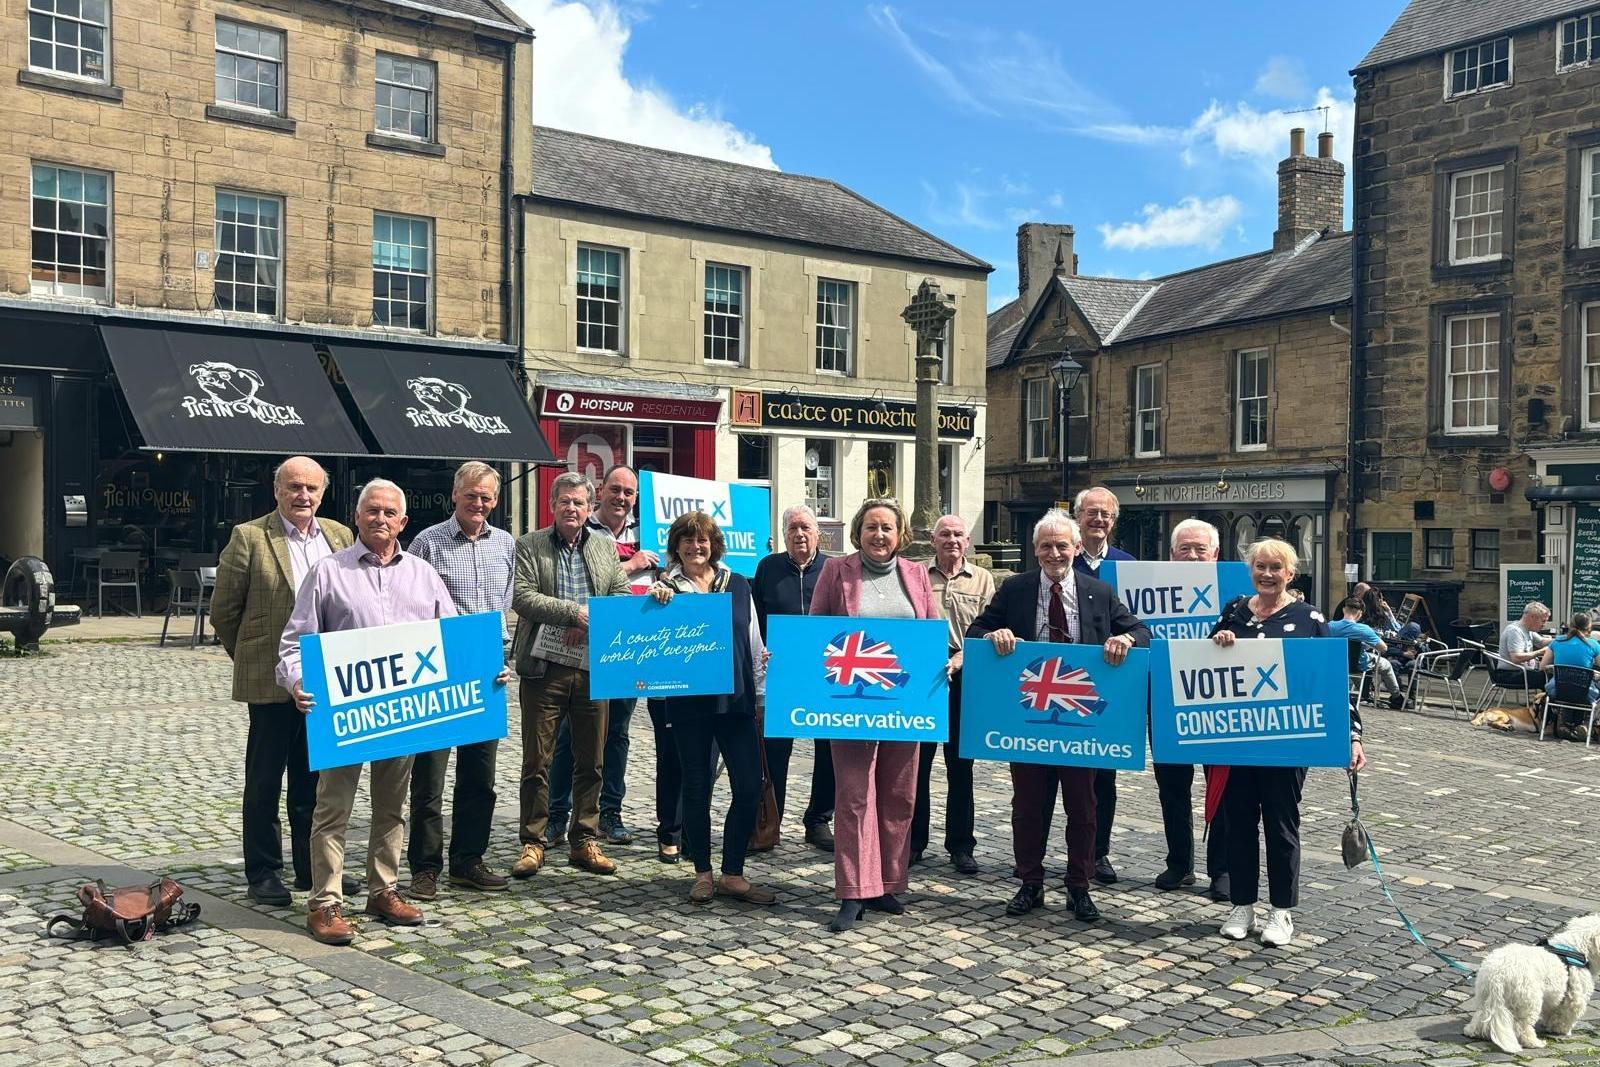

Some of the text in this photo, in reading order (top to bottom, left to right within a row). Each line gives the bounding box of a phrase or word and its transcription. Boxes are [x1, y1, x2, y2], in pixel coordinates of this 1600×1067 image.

[181, 395, 302, 424] PIG IN MUCK
[405, 406, 509, 433] PIG IN MUCK
[580, 398, 635, 413] HOTSPUR
[641, 403, 708, 417] RESIDENTIAL
[104, 483, 191, 513] PIG IN MUCK
[1138, 481, 1285, 501] HE NORTHERN ANGELS
[660, 496, 705, 520] VOTE
[1125, 586, 1184, 616] VOTE
[609, 621, 711, 650] A county that
[599, 648, 636, 664] works
[636, 645, 660, 665] for
[334, 652, 407, 698] VOTE
[1179, 665, 1248, 700] VOTE
[332, 679, 484, 738] CONSERVATIVE
[790, 707, 936, 730] Conservatives
[1175, 703, 1326, 736] CONSERVATIVE
[984, 730, 1133, 759] Conservatives
